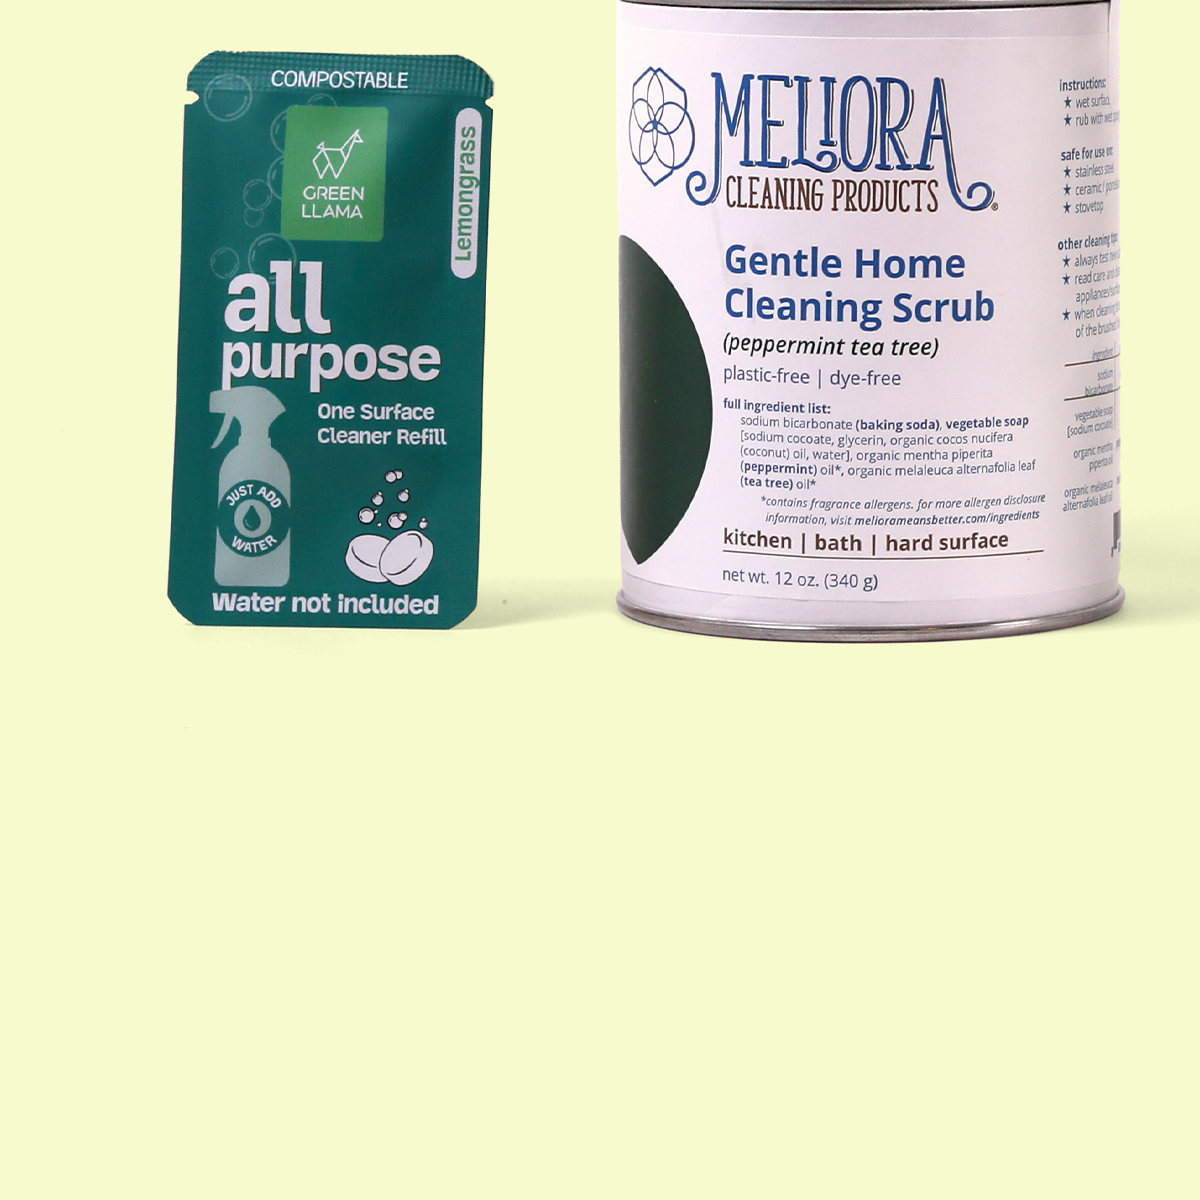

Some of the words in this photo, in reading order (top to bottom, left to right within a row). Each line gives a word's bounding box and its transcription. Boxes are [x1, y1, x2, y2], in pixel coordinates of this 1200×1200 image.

[270, 69, 408, 90] COMPOSTABLE
[1075, 113, 1089, 126] rub
[686, 72, 995, 211] MELIORA
[1061, 148, 1080, 161] safe
[1082, 147, 1093, 159] for
[1095, 147, 1105, 158] use
[1075, 164, 1104, 178] stainless
[303, 185, 364, 201] GREEN
[454, 125, 480, 261] Lemongrass
[726, 175, 823, 211] CLEANING
[831, 179, 938, 212] PRODUCTS
[1075, 182, 1102, 196] ceramic
[301, 203, 363, 220] LLAMA
[1075, 200, 1104, 214] stovetop
[1058, 237, 1082, 250] other
[725, 243, 842, 278] Gentle
[856, 249, 966, 279] Home
[1074, 254, 1098, 269] always
[1074, 271, 1092, 285] read
[1093, 272, 1106, 282] care
[224, 260, 331, 334] all
[725, 287, 882, 332] Cleaning
[893, 290, 995, 323] Scrub
[1074, 307, 1094, 320] when
[1075, 324, 1084, 338] of
[1085, 324, 1097, 337] the
[723, 332, 845, 358] (peppermint
[851, 339, 884, 356] tea
[891, 338, 940, 359] tree)
[221, 340, 442, 392] purpose
[724, 365, 810, 384] plastic-free
[830, 370, 901, 389] dye-free
[317, 402, 356, 421] One
[360, 402, 435, 421] Surface
[723, 398, 741, 409] full
[744, 400, 805, 416] ingredient
[808, 403, 831, 414] list:
[740, 416, 780, 428] sodium
[783, 417, 852, 430] bicarbonate
[855, 419, 903, 433] (baking
[906, 418, 942, 432] soda),
[946, 417, 1002, 432] vegetable
[1004, 416, 1029, 429] soap
[317, 426, 391, 446] Cleaner
[397, 427, 447, 446] Refill
[740, 430, 784, 443] [sodium
[787, 433, 835, 446] cocoate,
[838, 433, 887, 448] glycerin,
[890, 434, 934, 448] organic
[936, 433, 968, 445] cocos
[971, 431, 1013, 444] nucifera
[740, 446, 790, 459] (coconut)
[793, 448, 809, 460] oil,
[812, 449, 853, 462] water],
[856, 450, 900, 463] organic
[903, 449, 948, 460] mentha
[951, 447, 993, 462] piperita
[1073, 446, 1096, 460] organic
[740, 461, 817, 476] (peppermint)
[847, 465, 892, 478] organic
[895, 464, 953, 476] melaleuca
[956, 461, 1015, 475] alternafolia
[1018, 459, 1036, 471] leaf
[740, 476, 762, 488] (tea
[765, 477, 793, 490] tree)
[1064, 485, 1089, 499] organic
[225, 483, 254, 507] JUST
[256, 484, 282, 510] ADD
[810, 498, 861, 512] fragrance
[864, 498, 914, 512] allergens.
[917, 498, 932, 511] for
[935, 498, 961, 508] more
[964, 495, 1001, 510] allergen
[1004, 493, 1046, 505] disclosure
[765, 512, 827, 526] information,
[831, 514, 851, 526] visit
[854, 510, 1040, 526] meliorameansbetter.com/ingredients
[230, 533, 278, 554] WATER
[723, 528, 792, 549] kitchen
[815, 534, 862, 551] bath
[886, 534, 933, 551] hard
[939, 532, 1009, 551] surface
[723, 568, 744, 582] net
[748, 571, 769, 585] wt.
[775, 572, 792, 586] 12
[797, 576, 820, 587] oz.
[824, 574, 858, 589] (340
[863, 574, 878, 591] g)
[212, 591, 285, 615] Water
[291, 594, 331, 615] not
[337, 593, 439, 615] included
